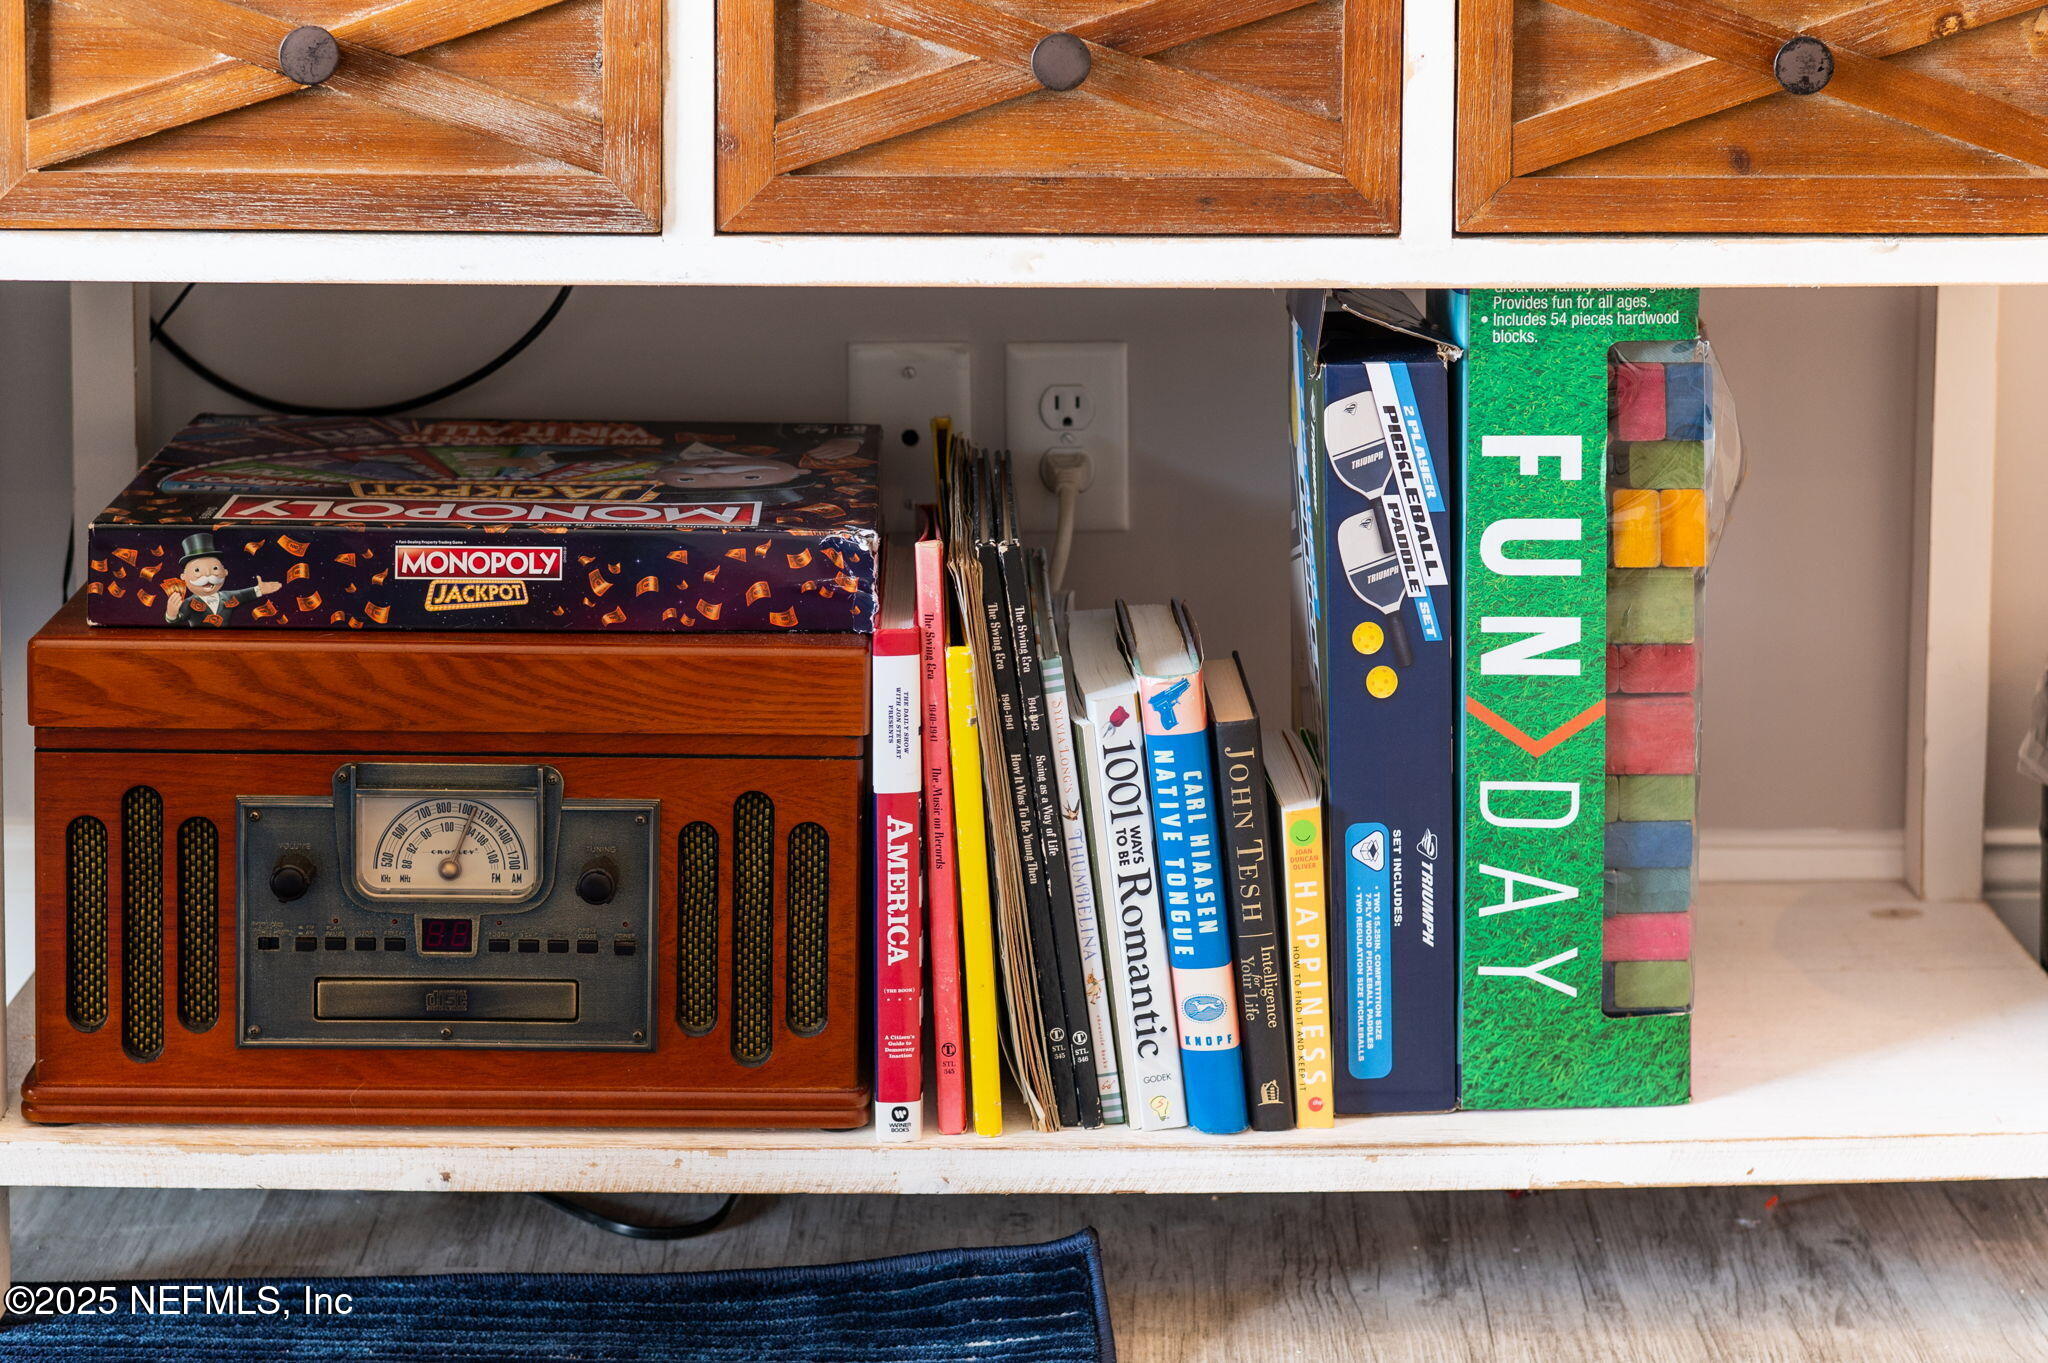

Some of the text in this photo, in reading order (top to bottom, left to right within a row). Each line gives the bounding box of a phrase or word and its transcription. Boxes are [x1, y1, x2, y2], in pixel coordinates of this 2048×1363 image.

[1493, 295, 1651, 311] Provides fun for all ages.
[1493, 311, 1679, 328] Includes 54 pieces hardwood
[1492, 329, 1538, 343] blocks.
[1403, 406, 1437, 499] 2 PLAYER
[368, 484, 643, 500] JACKPOT
[1383, 406, 1438, 577] PICKLEBALL
[240, 501, 741, 523] MONOPOLY
[1387, 503, 1422, 593] PADDLE
[401, 551, 558, 575] MONOPOLY
[434, 584, 522, 605] JACKPOT
[1014, 606, 1025, 623] The
[1419, 602, 1437, 640] SET
[1015, 625, 1029, 656] Swing
[1021, 657, 1032, 674] Era
[1477, 436, 1582, 998] FUN DAY
[923, 614, 946, 871] The Swing Era 1940-1941 The Music on Records
[987, 603, 1040, 886] The Swing Era 1940-1941 How It Was To Be Young Then
[1034, 756, 1049, 784] Swing
[1039, 785, 1048, 796] as
[440, 821, 455, 833] 100
[1041, 806, 1054, 828] Way
[381, 802, 521, 871] 530 600 700 800 1200 1400 1700
[474, 832, 489, 846] 106
[1046, 829, 1057, 839] of
[1050, 698, 1067, 745] SYLVIA
[1067, 828, 1097, 962] THUMBELINA
[1224, 747, 1265, 923] JOHN TESH
[406, 843, 418, 855] 92
[486, 850, 499, 864] 108
[1047, 841, 1059, 858] Life
[1154, 750, 1195, 957] NATIVE TONGUE
[1182, 770, 1219, 934] CARL HIAASEN
[1290, 855, 1319, 864] DUNCAN
[1296, 848, 1313, 856] JOAN
[401, 859, 413, 870] 88
[1293, 862, 1317, 871] OLIVER
[380, 873, 522, 884] KHz MHz FM AM
[1392, 829, 1403, 928] SET INCLUDES:
[887, 816, 913, 967] AMERICA
[1101, 740, 1168, 1059] 1001 WAYS TO BE Romantic
[1373, 892, 1381, 913] TWO
[1365, 893, 1373, 918] 7-PLY
[1421, 861, 1435, 949] TRIUMPH
[1365, 920, 1373, 949] WOOD
[1240, 956, 1260, 1022] Your Life
[1251, 974, 1263, 988] for
[1259, 944, 1278, 1029] Intelligence
[1294, 881, 1326, 1085] HAPPINESS
[1355, 893, 1366, 1063] TWO REGULATION SIZE PICKLEBALLS
[1374, 954, 1382, 1018] COMPETITION
[1293, 947, 1307, 1093] HOW TO FIND IT AND KEEP IT
[1366, 1009, 1374, 1050] PADDLES
[1375, 1019, 1383, 1041] SIZE
[1052, 1045, 1066, 1053] STL
[1185, 1034, 1232, 1045] KNOPF
[1075, 1047, 1089, 1056] STL
[1143, 1073, 1172, 1084] GODEK
